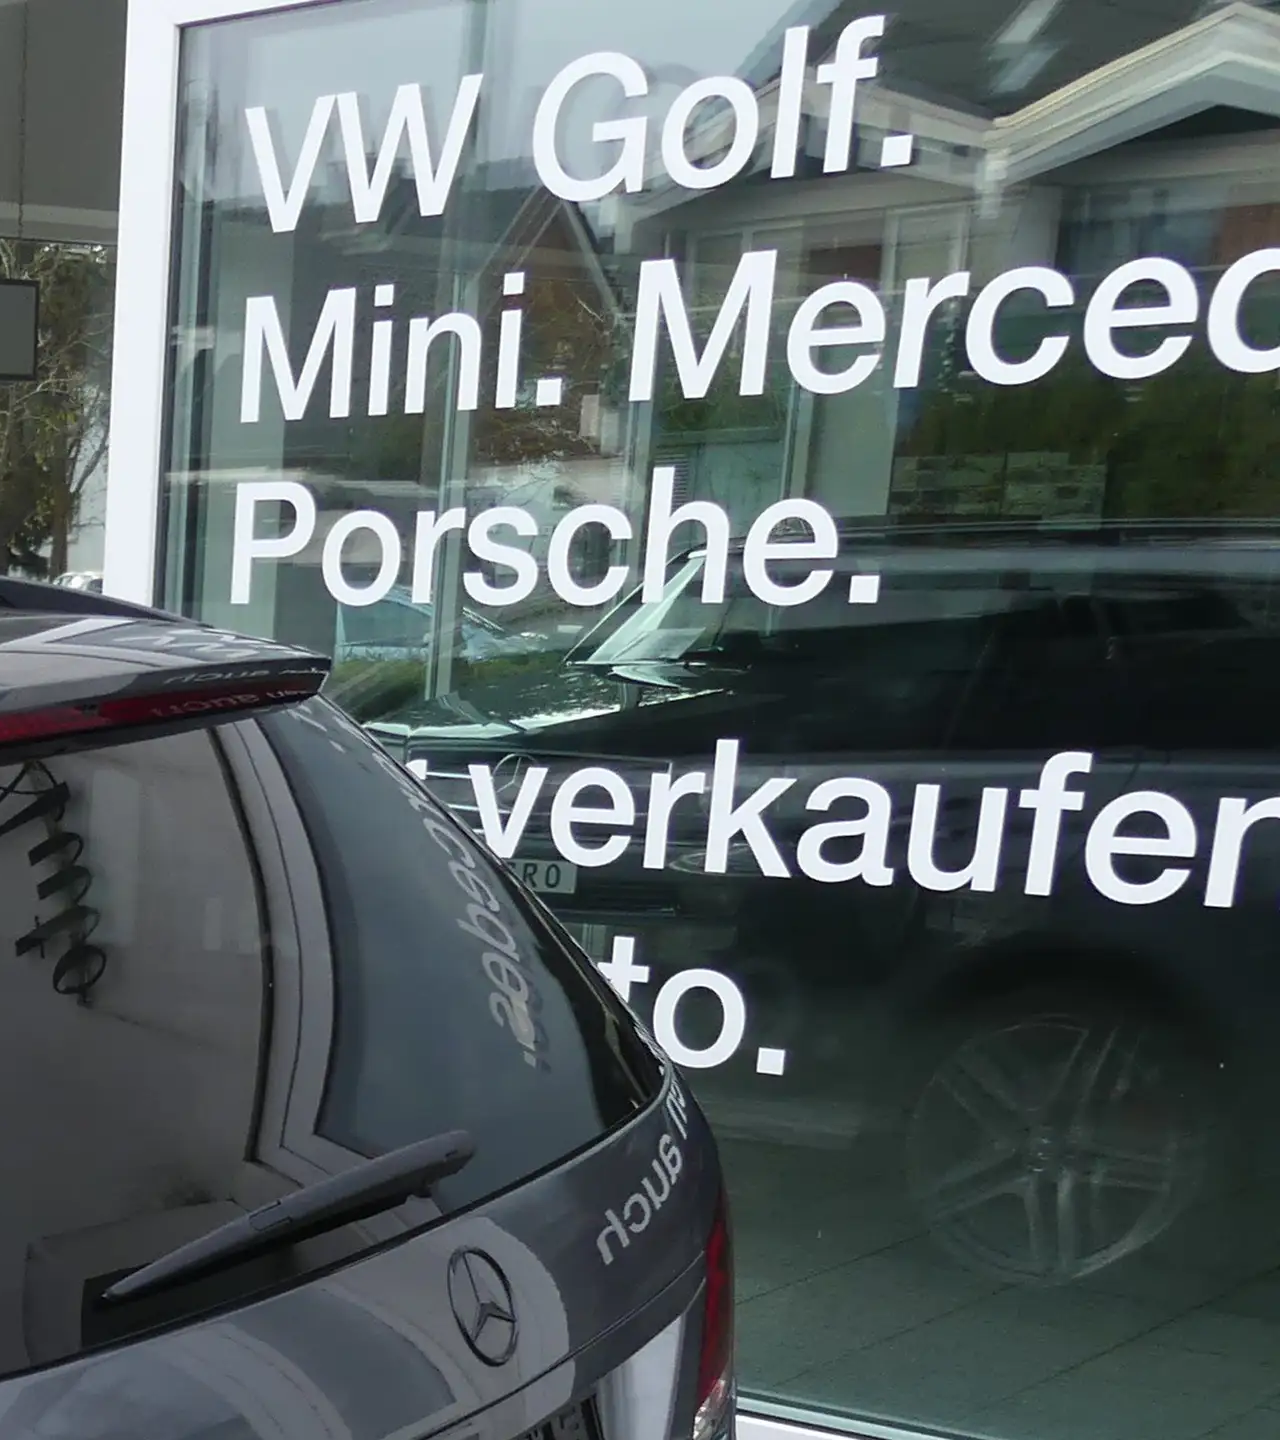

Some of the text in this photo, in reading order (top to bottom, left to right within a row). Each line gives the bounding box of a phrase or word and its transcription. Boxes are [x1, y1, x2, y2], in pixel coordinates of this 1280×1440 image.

[244, 15, 914, 233] VW Golf.
[240, 272, 564, 423] Mini.
[230, 466, 884, 613] Porsche.
[506, 861, 562, 889] RO
